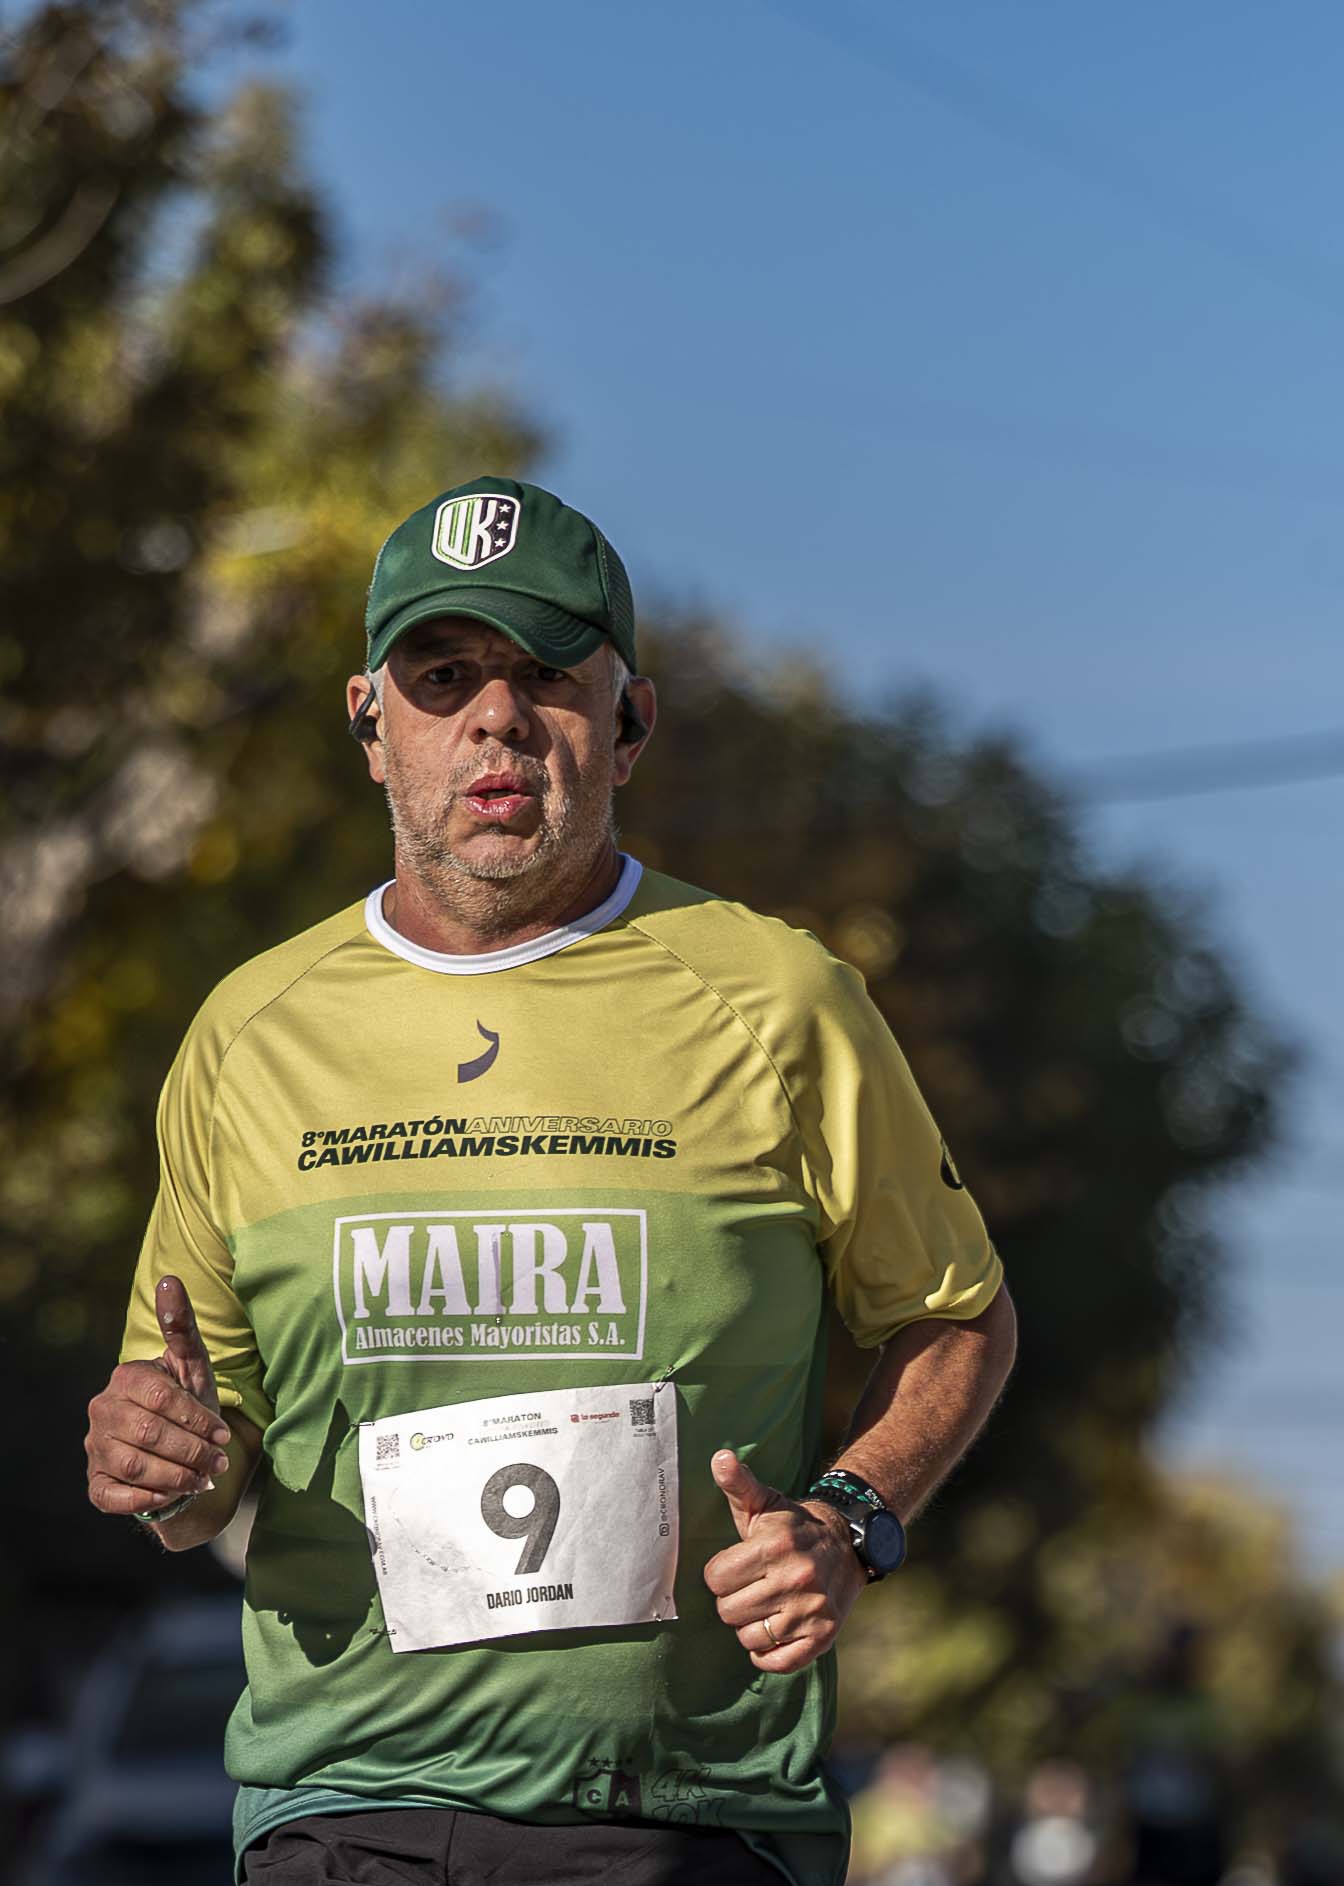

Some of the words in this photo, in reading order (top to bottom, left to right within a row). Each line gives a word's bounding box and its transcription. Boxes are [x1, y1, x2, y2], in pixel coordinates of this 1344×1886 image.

[466, 1116, 673, 1137] ANIVERSARIO
[297, 1135, 678, 1171] CAWILLIAMSKEMMIS
[350, 1223, 626, 1318] MAIRA
[356, 1326, 464, 1349] Almacenes
[471, 1323, 581, 1349] Mayoristas
[588, 1322, 625, 1346] S.A.
[480, 1462, 561, 1576] 9
[486, 1590, 523, 1610] DARIO
[526, 1583, 574, 1604] JORDAN
